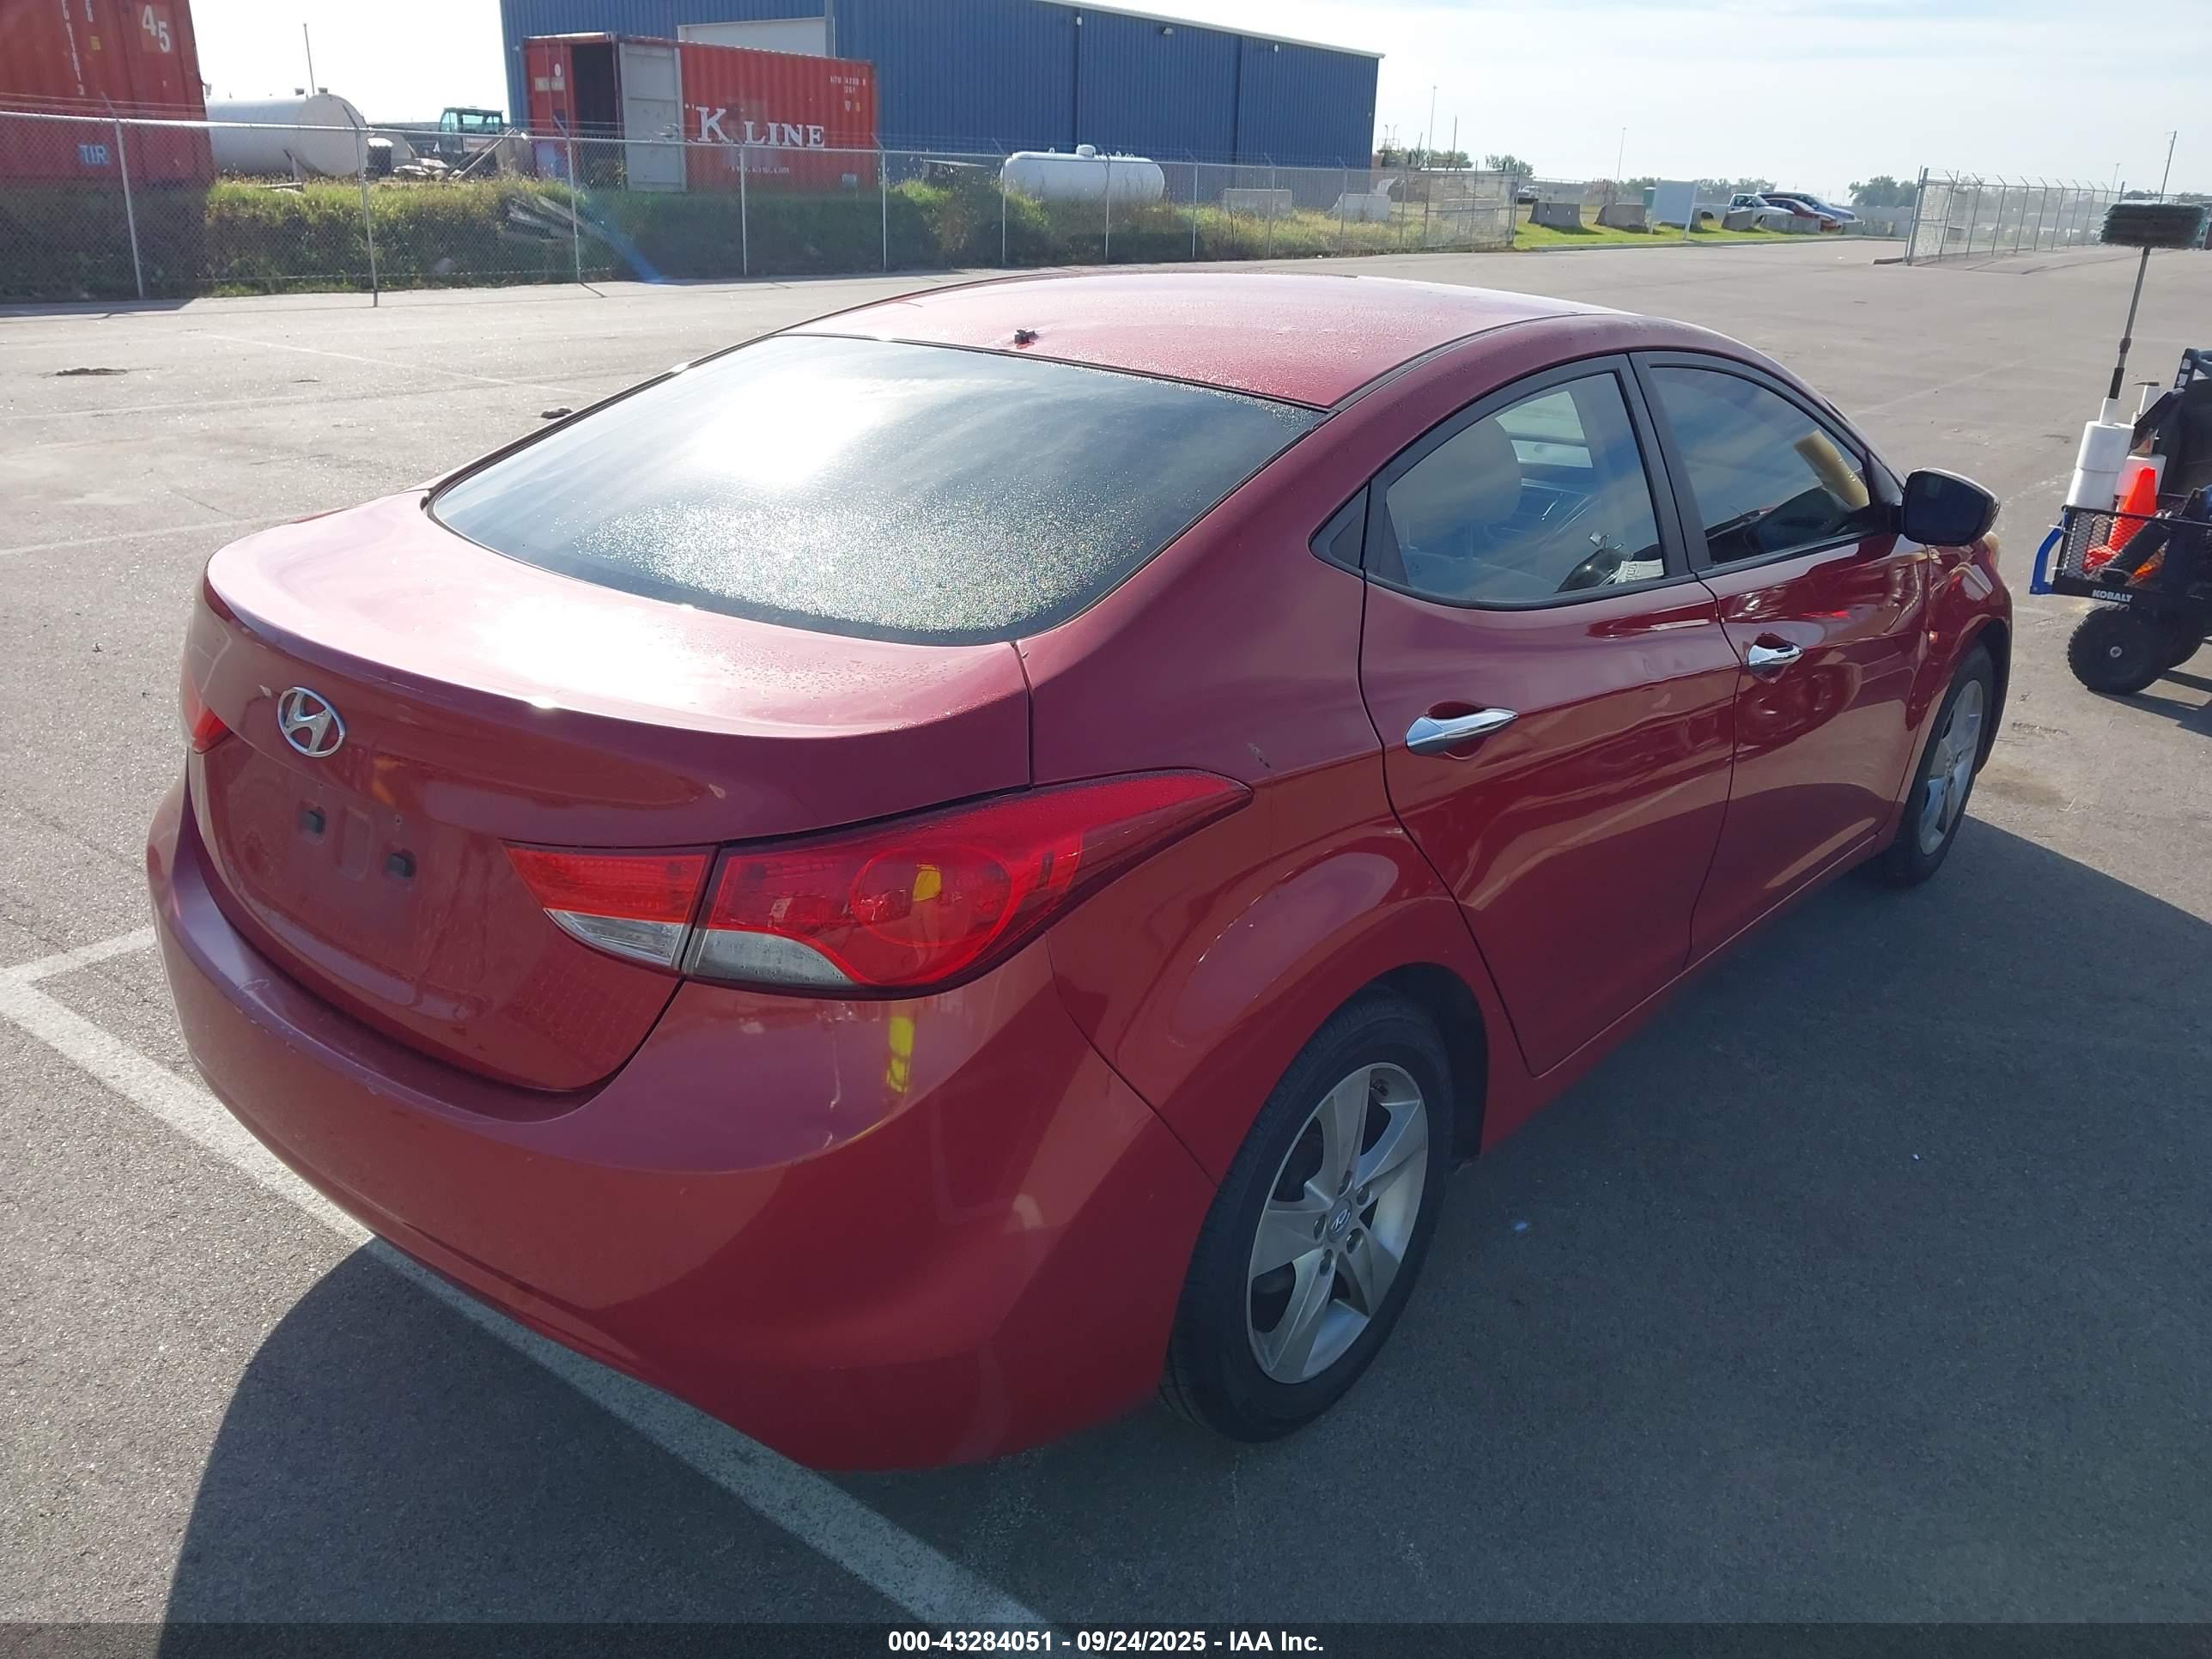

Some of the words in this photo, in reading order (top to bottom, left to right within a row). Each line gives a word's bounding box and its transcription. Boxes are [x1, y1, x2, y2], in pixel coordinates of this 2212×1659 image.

[142, 4, 171, 52] 45
[744, 121, 824, 147] LINE
[80, 145, 108, 163] TIR
[2093, 589, 2133, 602] KOBALT
